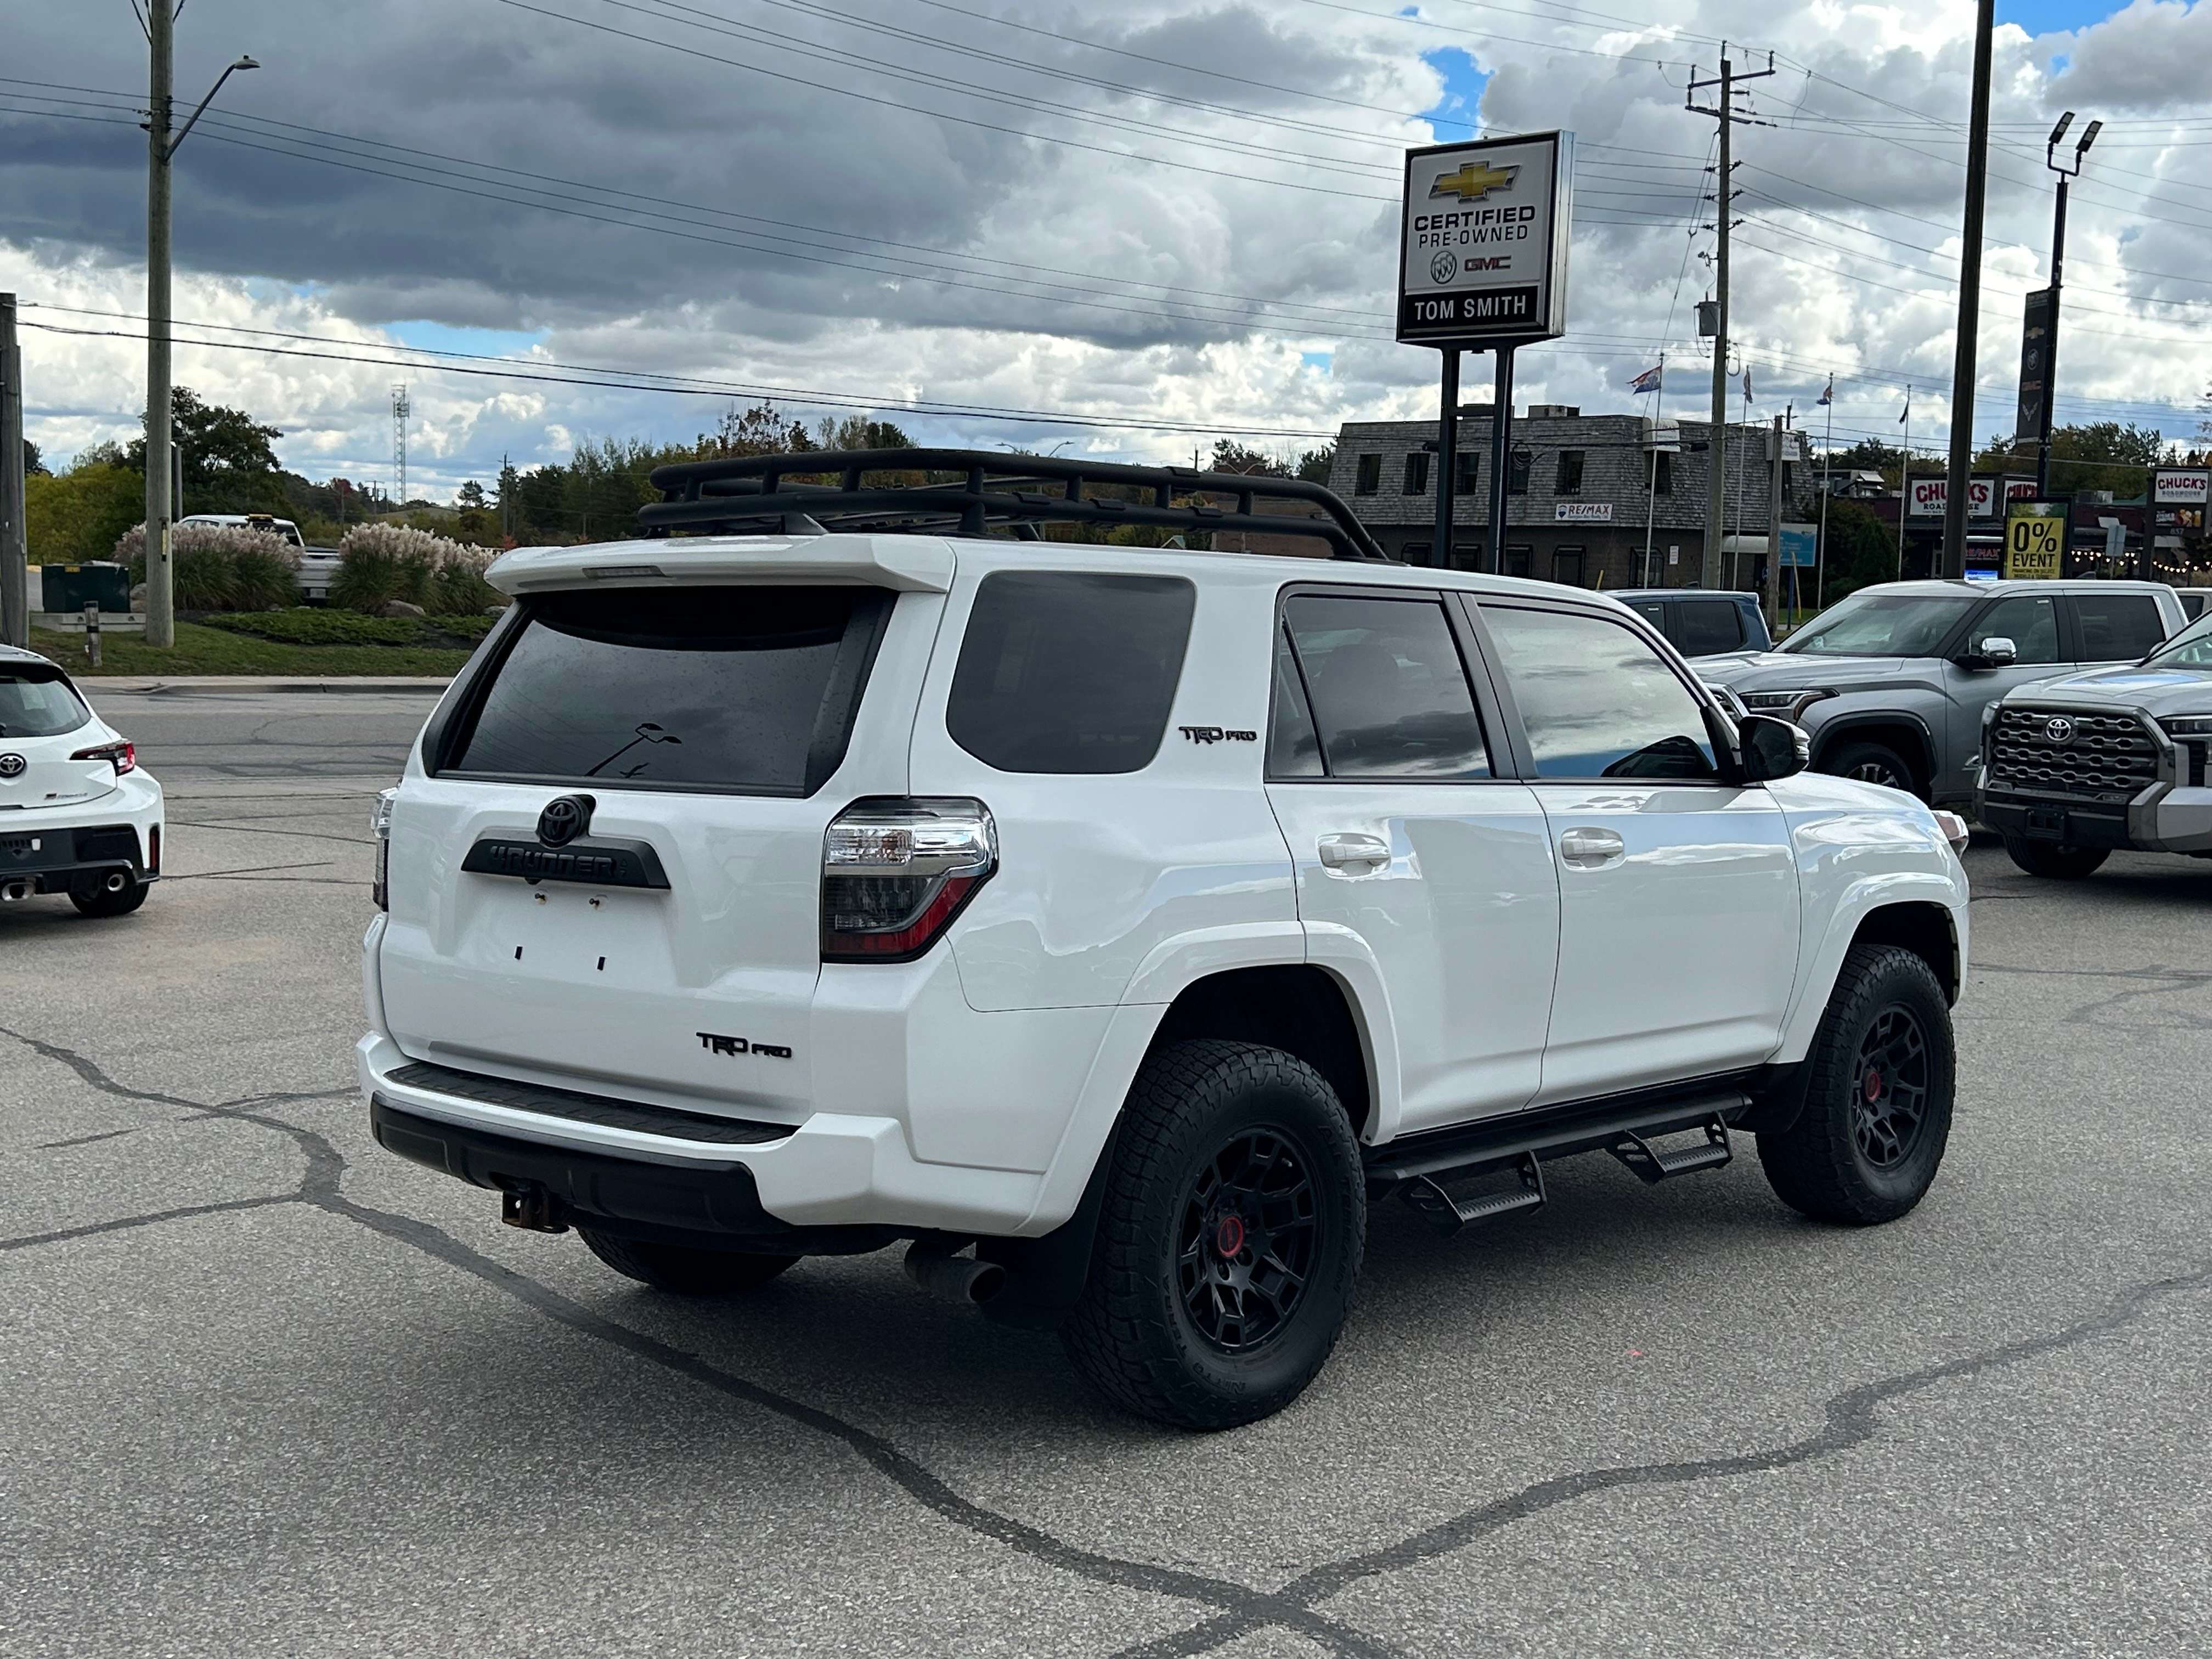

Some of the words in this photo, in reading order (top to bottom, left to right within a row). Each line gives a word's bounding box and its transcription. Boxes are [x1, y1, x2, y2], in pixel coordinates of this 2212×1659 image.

[1414, 206, 1535, 231] CERTIFIED
[1419, 225, 1528, 249] PRE-OWNED
[1464, 256, 1511, 272] GMC
[1415, 300, 1454, 320] TOM
[1464, 295, 1527, 318] SMITH
[1569, 505, 1609, 515] RE/MAX
[2014, 522, 2057, 552] 0%
[2013, 553, 2055, 567] EVENT
[1178, 726, 1224, 744] TRD
[696, 1032, 748, 1056] TRD
[752, 1043, 792, 1058] PRO
